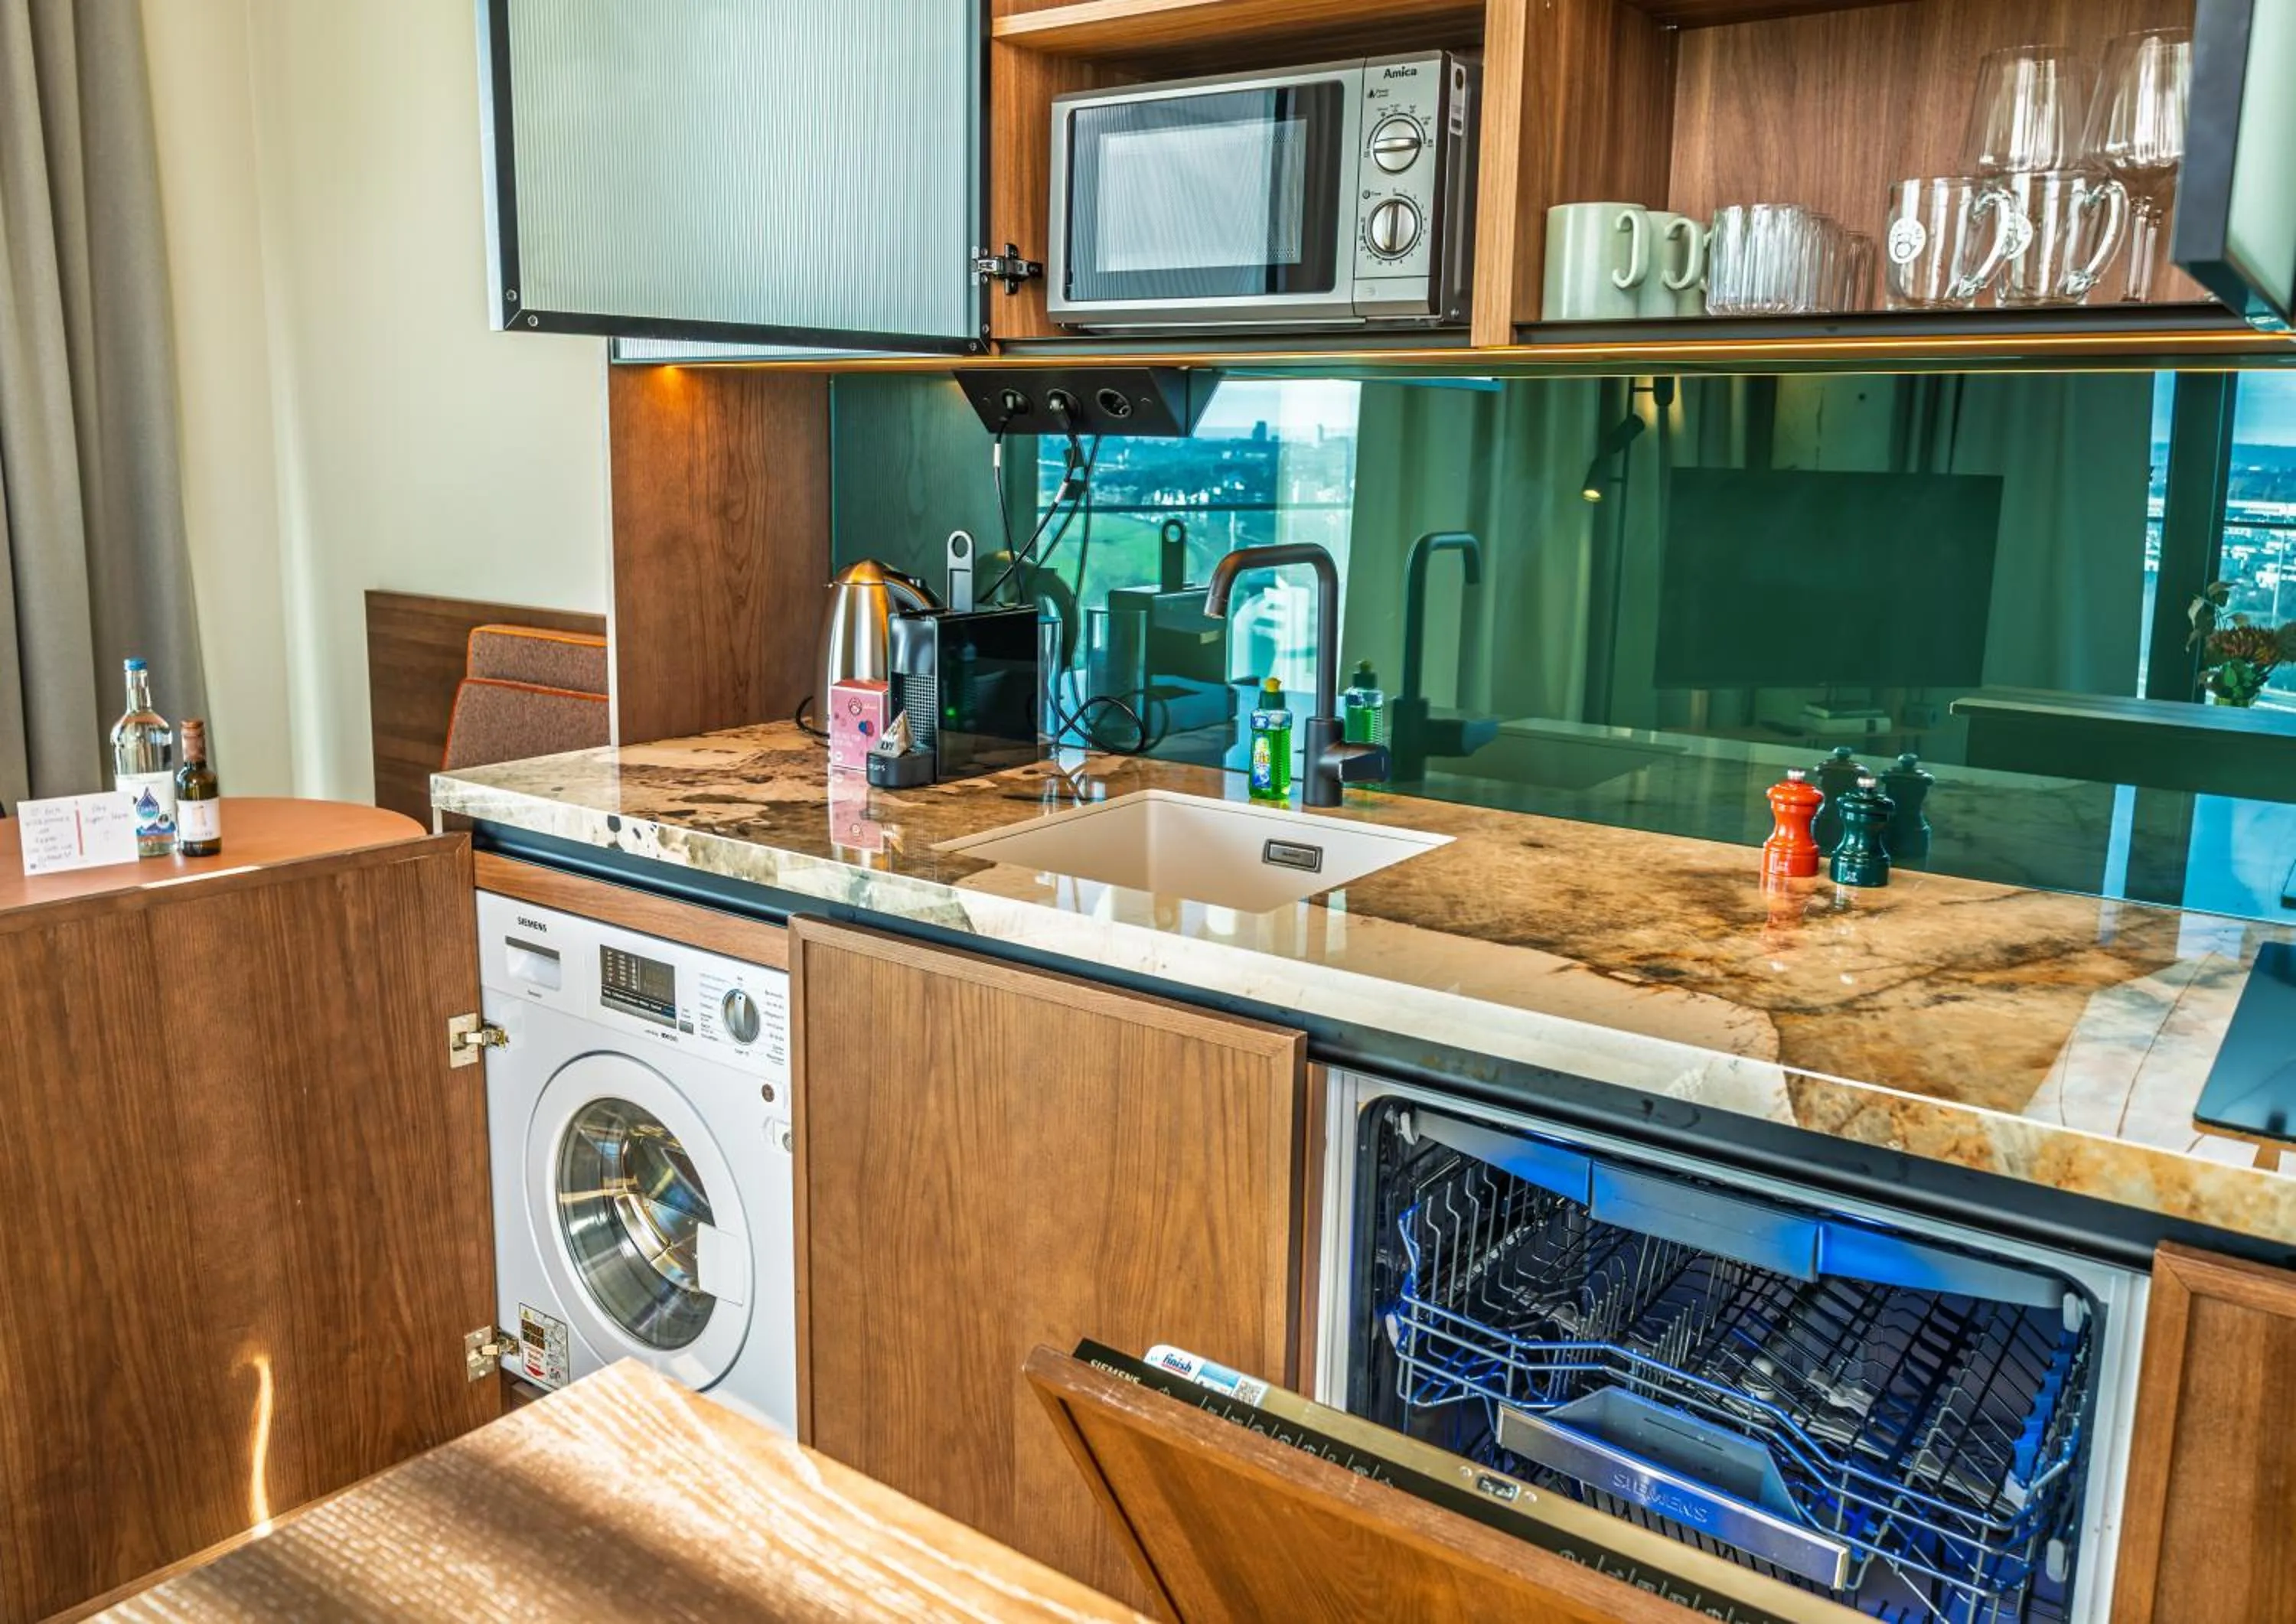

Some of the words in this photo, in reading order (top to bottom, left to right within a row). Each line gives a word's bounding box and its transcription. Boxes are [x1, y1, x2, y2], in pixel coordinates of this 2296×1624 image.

[1384, 66, 1417, 79] Amica
[517, 916, 547, 932] SIEMENS
[1090, 1359, 1140, 1384] SIEMENS
[1163, 1352, 1192, 1373] finish
[1613, 1473, 1707, 1522] SIEMENS
